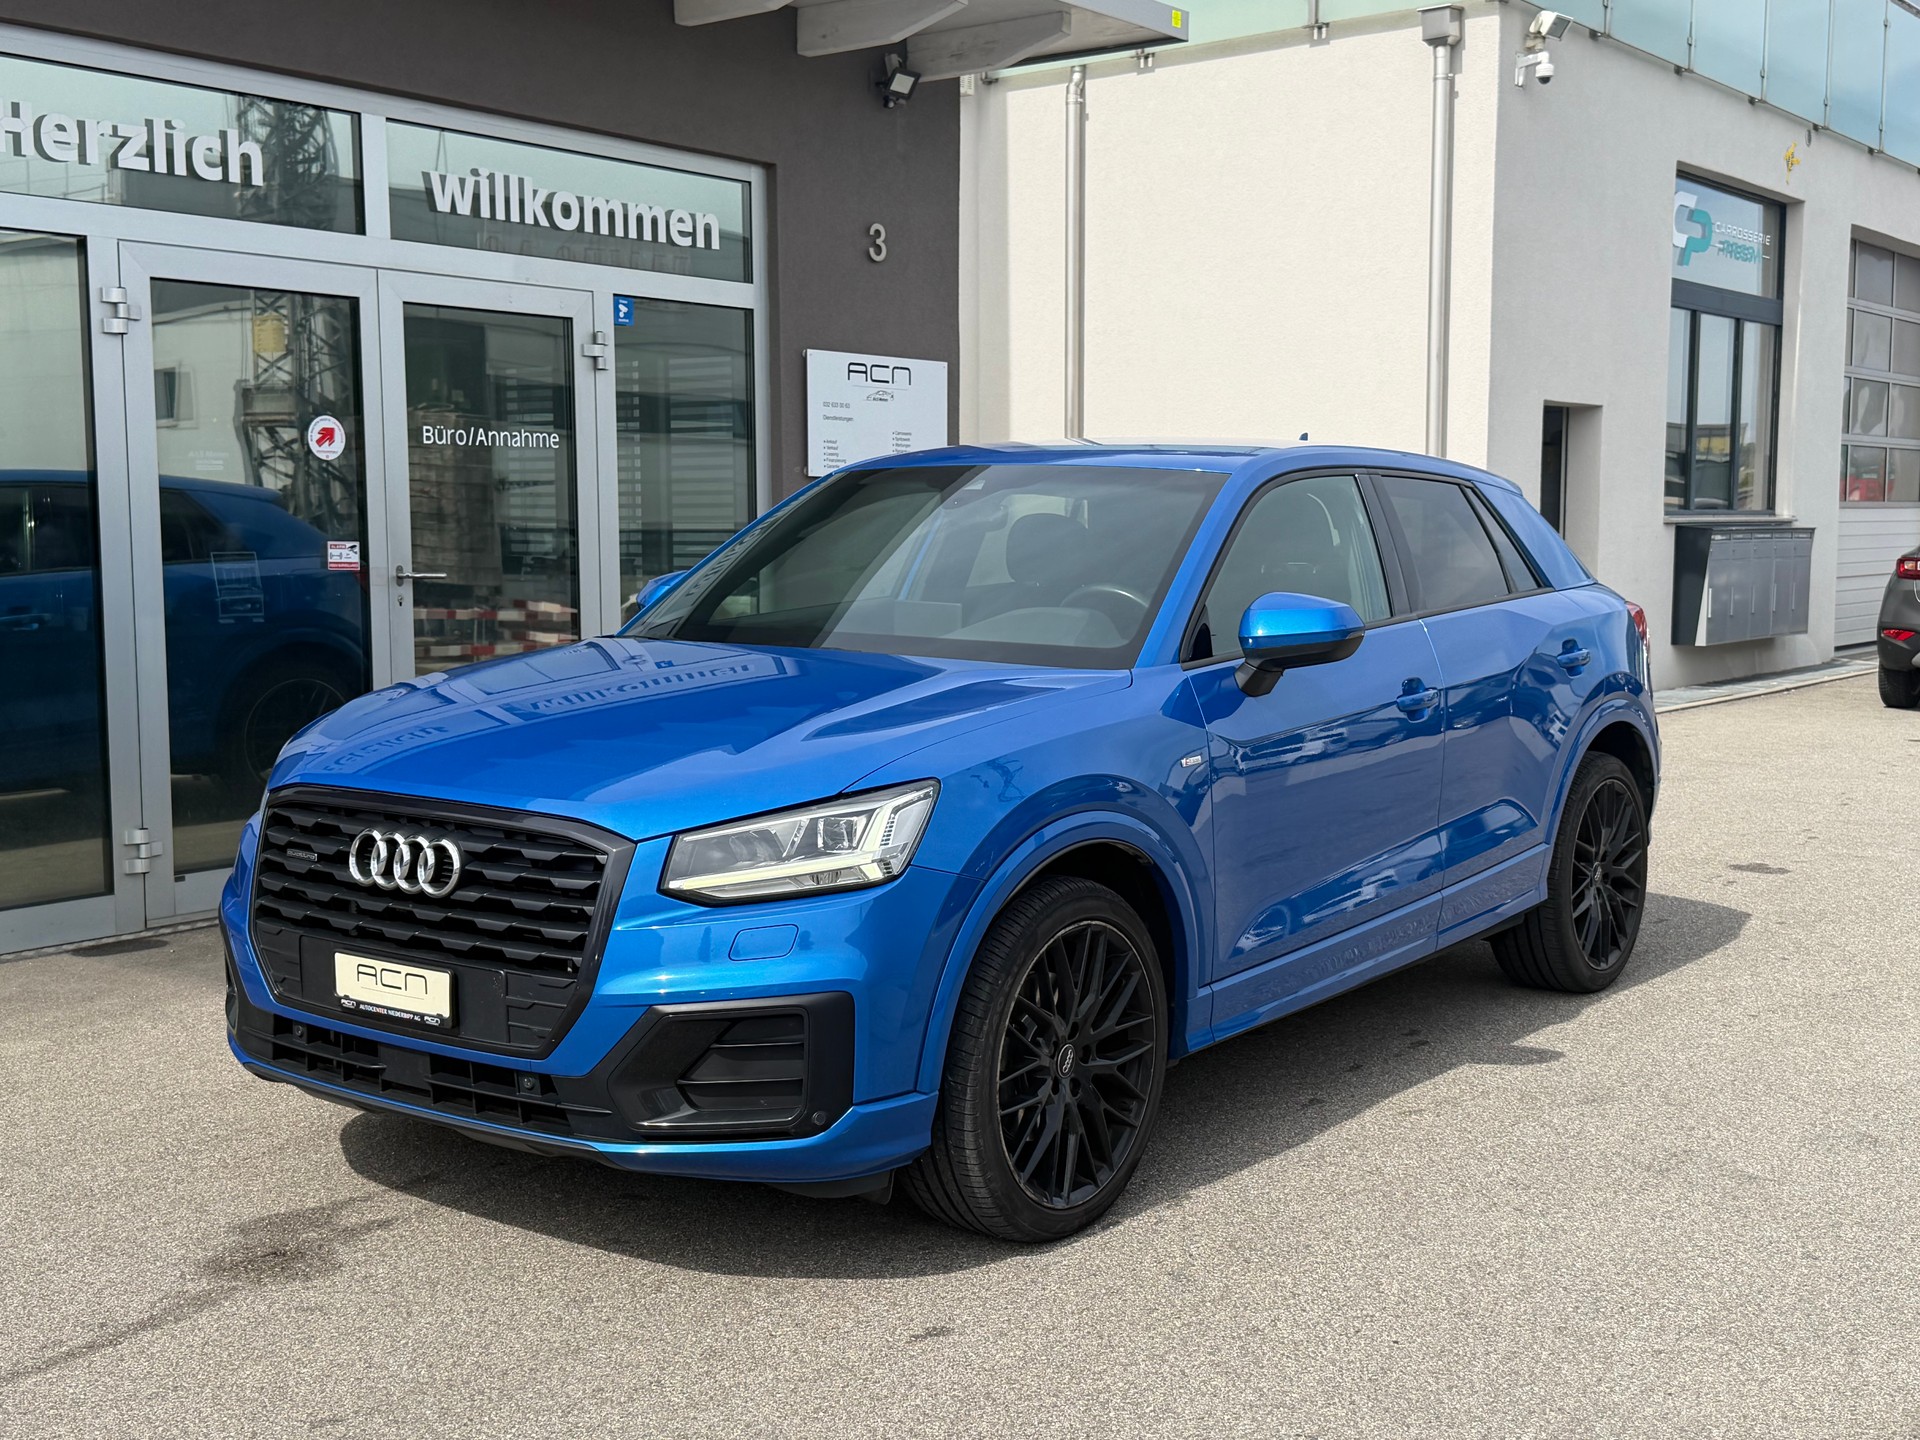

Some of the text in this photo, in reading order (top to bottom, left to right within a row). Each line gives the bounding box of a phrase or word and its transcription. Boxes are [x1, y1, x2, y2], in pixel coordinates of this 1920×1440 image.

[0, 99, 720, 250] Herzlich willkommen
[868, 222, 887, 263] 3
[1714, 221, 1772, 246] CARROSSERIE
[422, 425, 560, 449] Büro/Annahme
[359, 1003, 388, 1015] AUTOCENTER
[413, 1014, 422, 1022] AG
